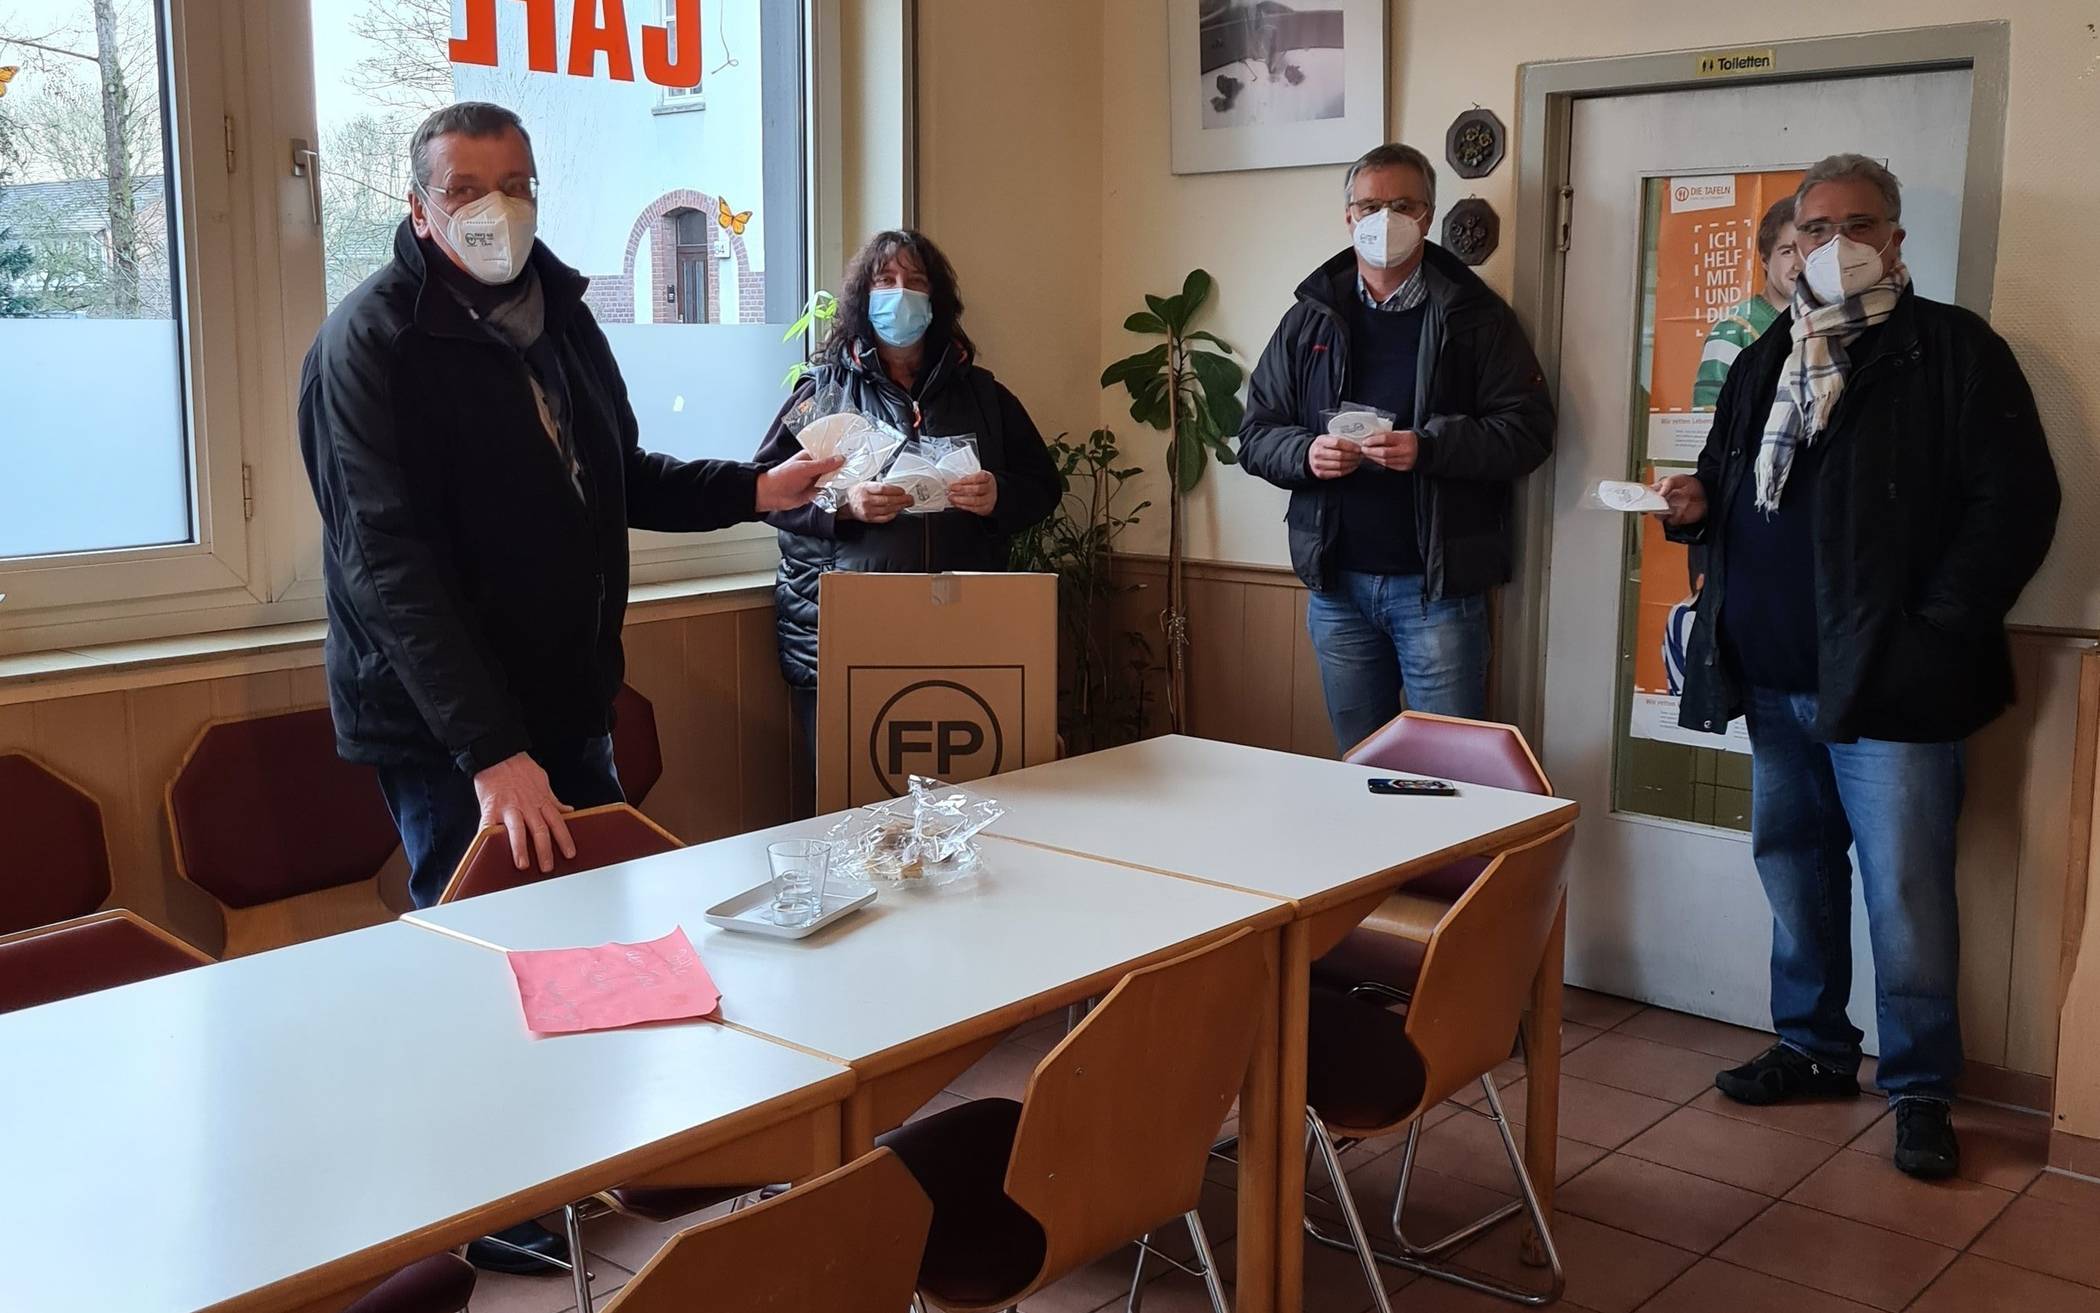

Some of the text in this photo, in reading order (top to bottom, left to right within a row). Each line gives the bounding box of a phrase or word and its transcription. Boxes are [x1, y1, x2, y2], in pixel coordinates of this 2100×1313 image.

[1717, 56, 1770, 71] Toiletten
[1690, 185, 1731, 196] DIE TAFELN
[1708, 231, 1737, 250] ICH
[1703, 249, 1742, 268] HELF
[1706, 268, 1740, 287] MIT.
[1704, 286, 1742, 305] UND
[1706, 305, 1740, 324] DU?
[888, 721, 984, 775] FP
